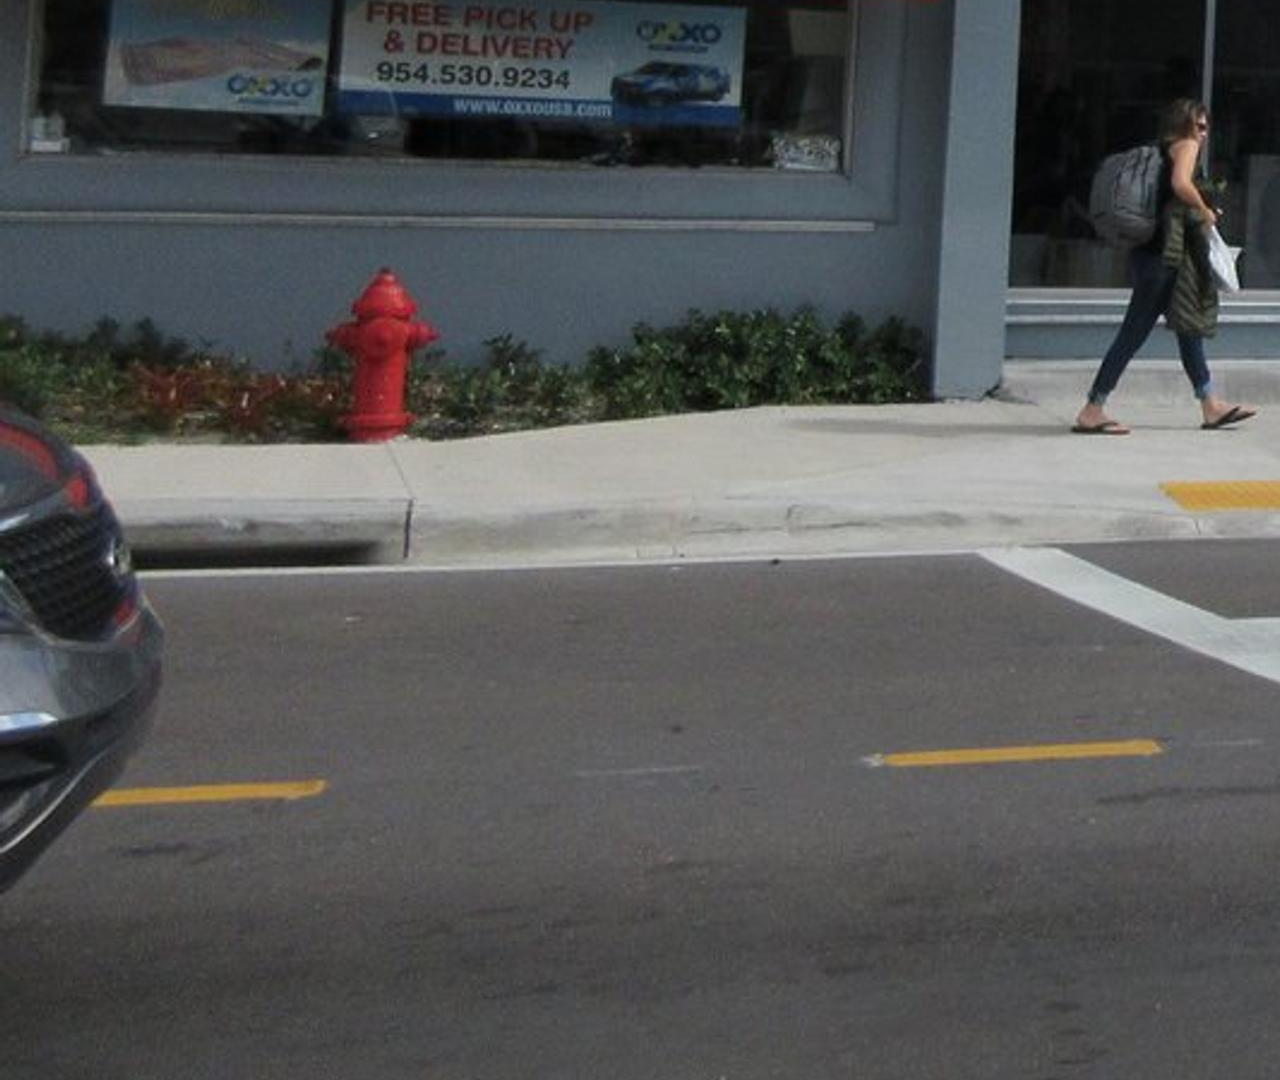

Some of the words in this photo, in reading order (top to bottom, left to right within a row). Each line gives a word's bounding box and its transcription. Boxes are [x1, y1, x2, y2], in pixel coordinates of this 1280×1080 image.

[366, 0, 455, 27] FREE
[464, 5, 539, 32] PICK
[552, 10, 594, 34] UP
[383, 30, 404, 54] &
[416, 32, 575, 60] DELIVERY
[376, 61, 571, 90] 954.530.9234
